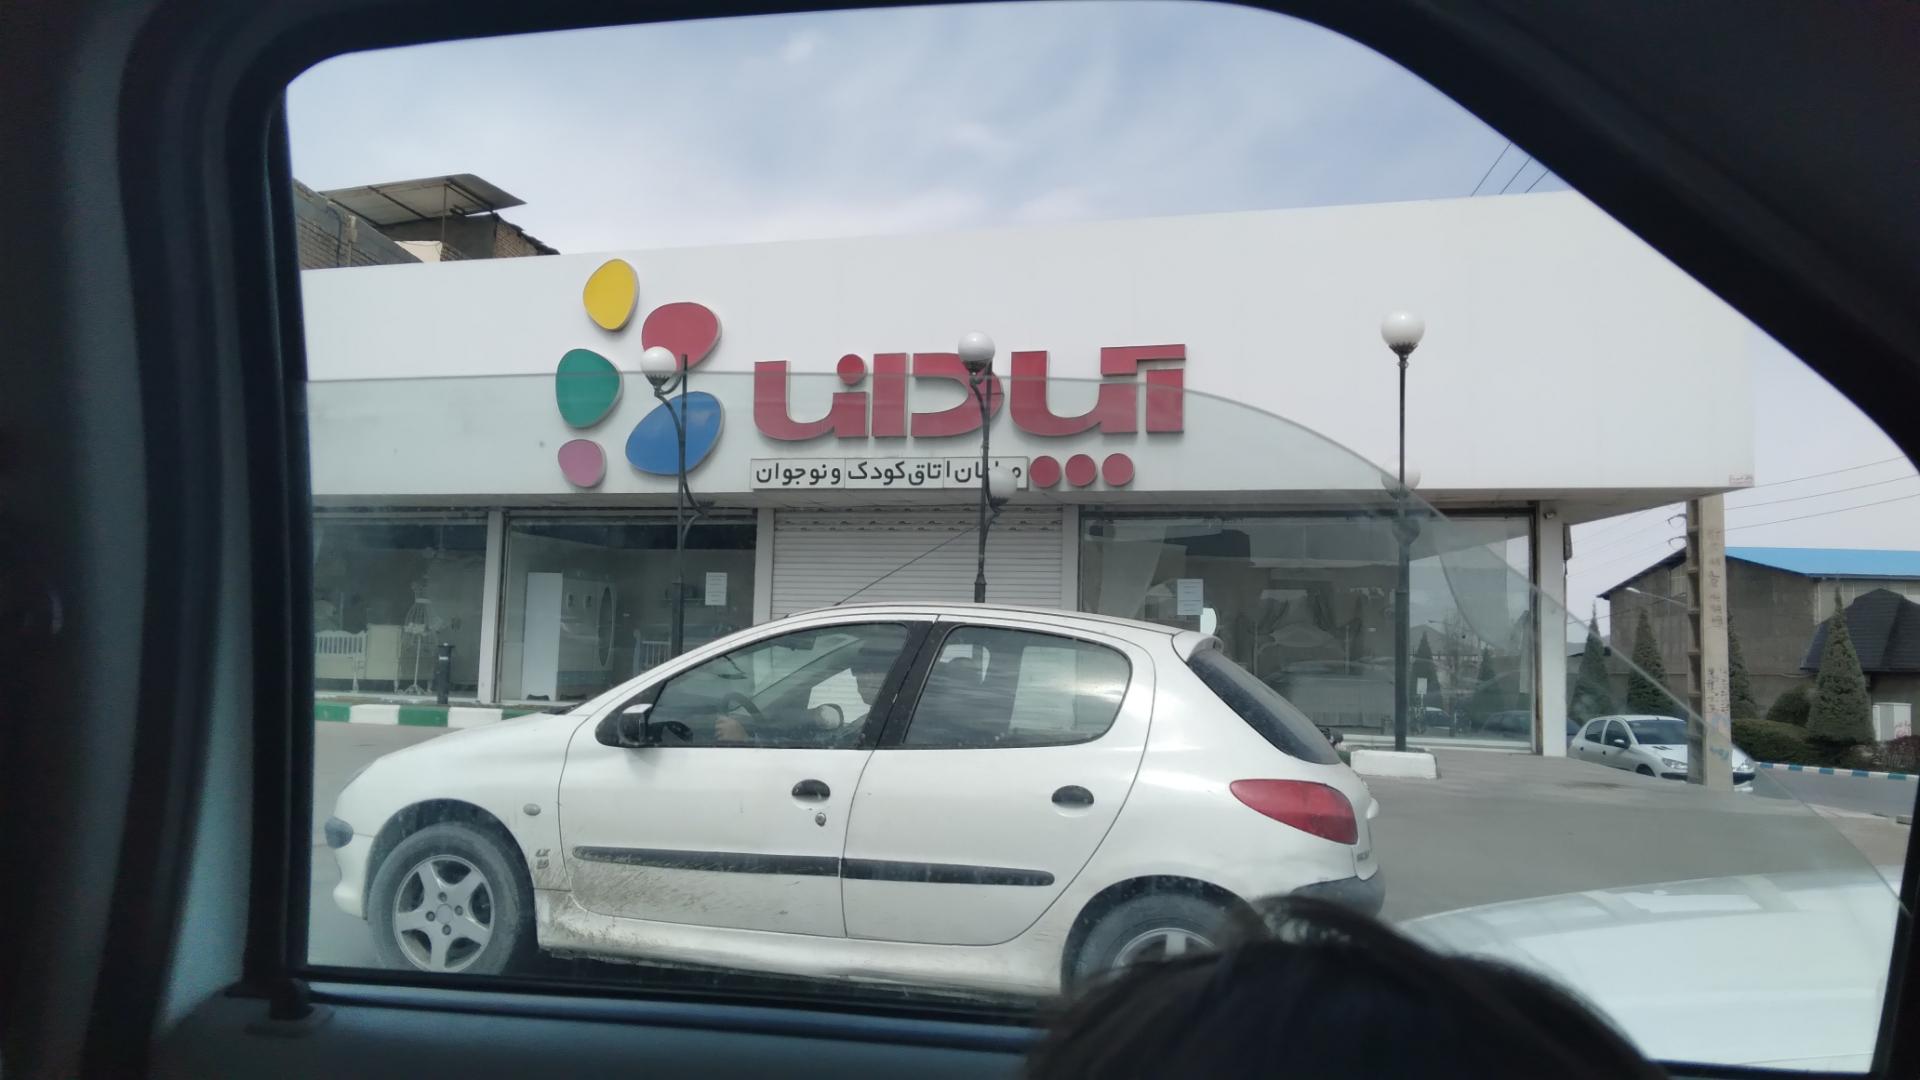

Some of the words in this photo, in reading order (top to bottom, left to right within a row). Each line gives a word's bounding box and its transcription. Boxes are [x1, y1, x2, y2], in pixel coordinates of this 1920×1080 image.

[756, 463, 827, 486] نوجوان
[831, 467, 841, 485] و
[848, 461, 905, 486] کودک
[908, 461, 950, 486] اتاق
[955, 460, 1021, 483] مان
